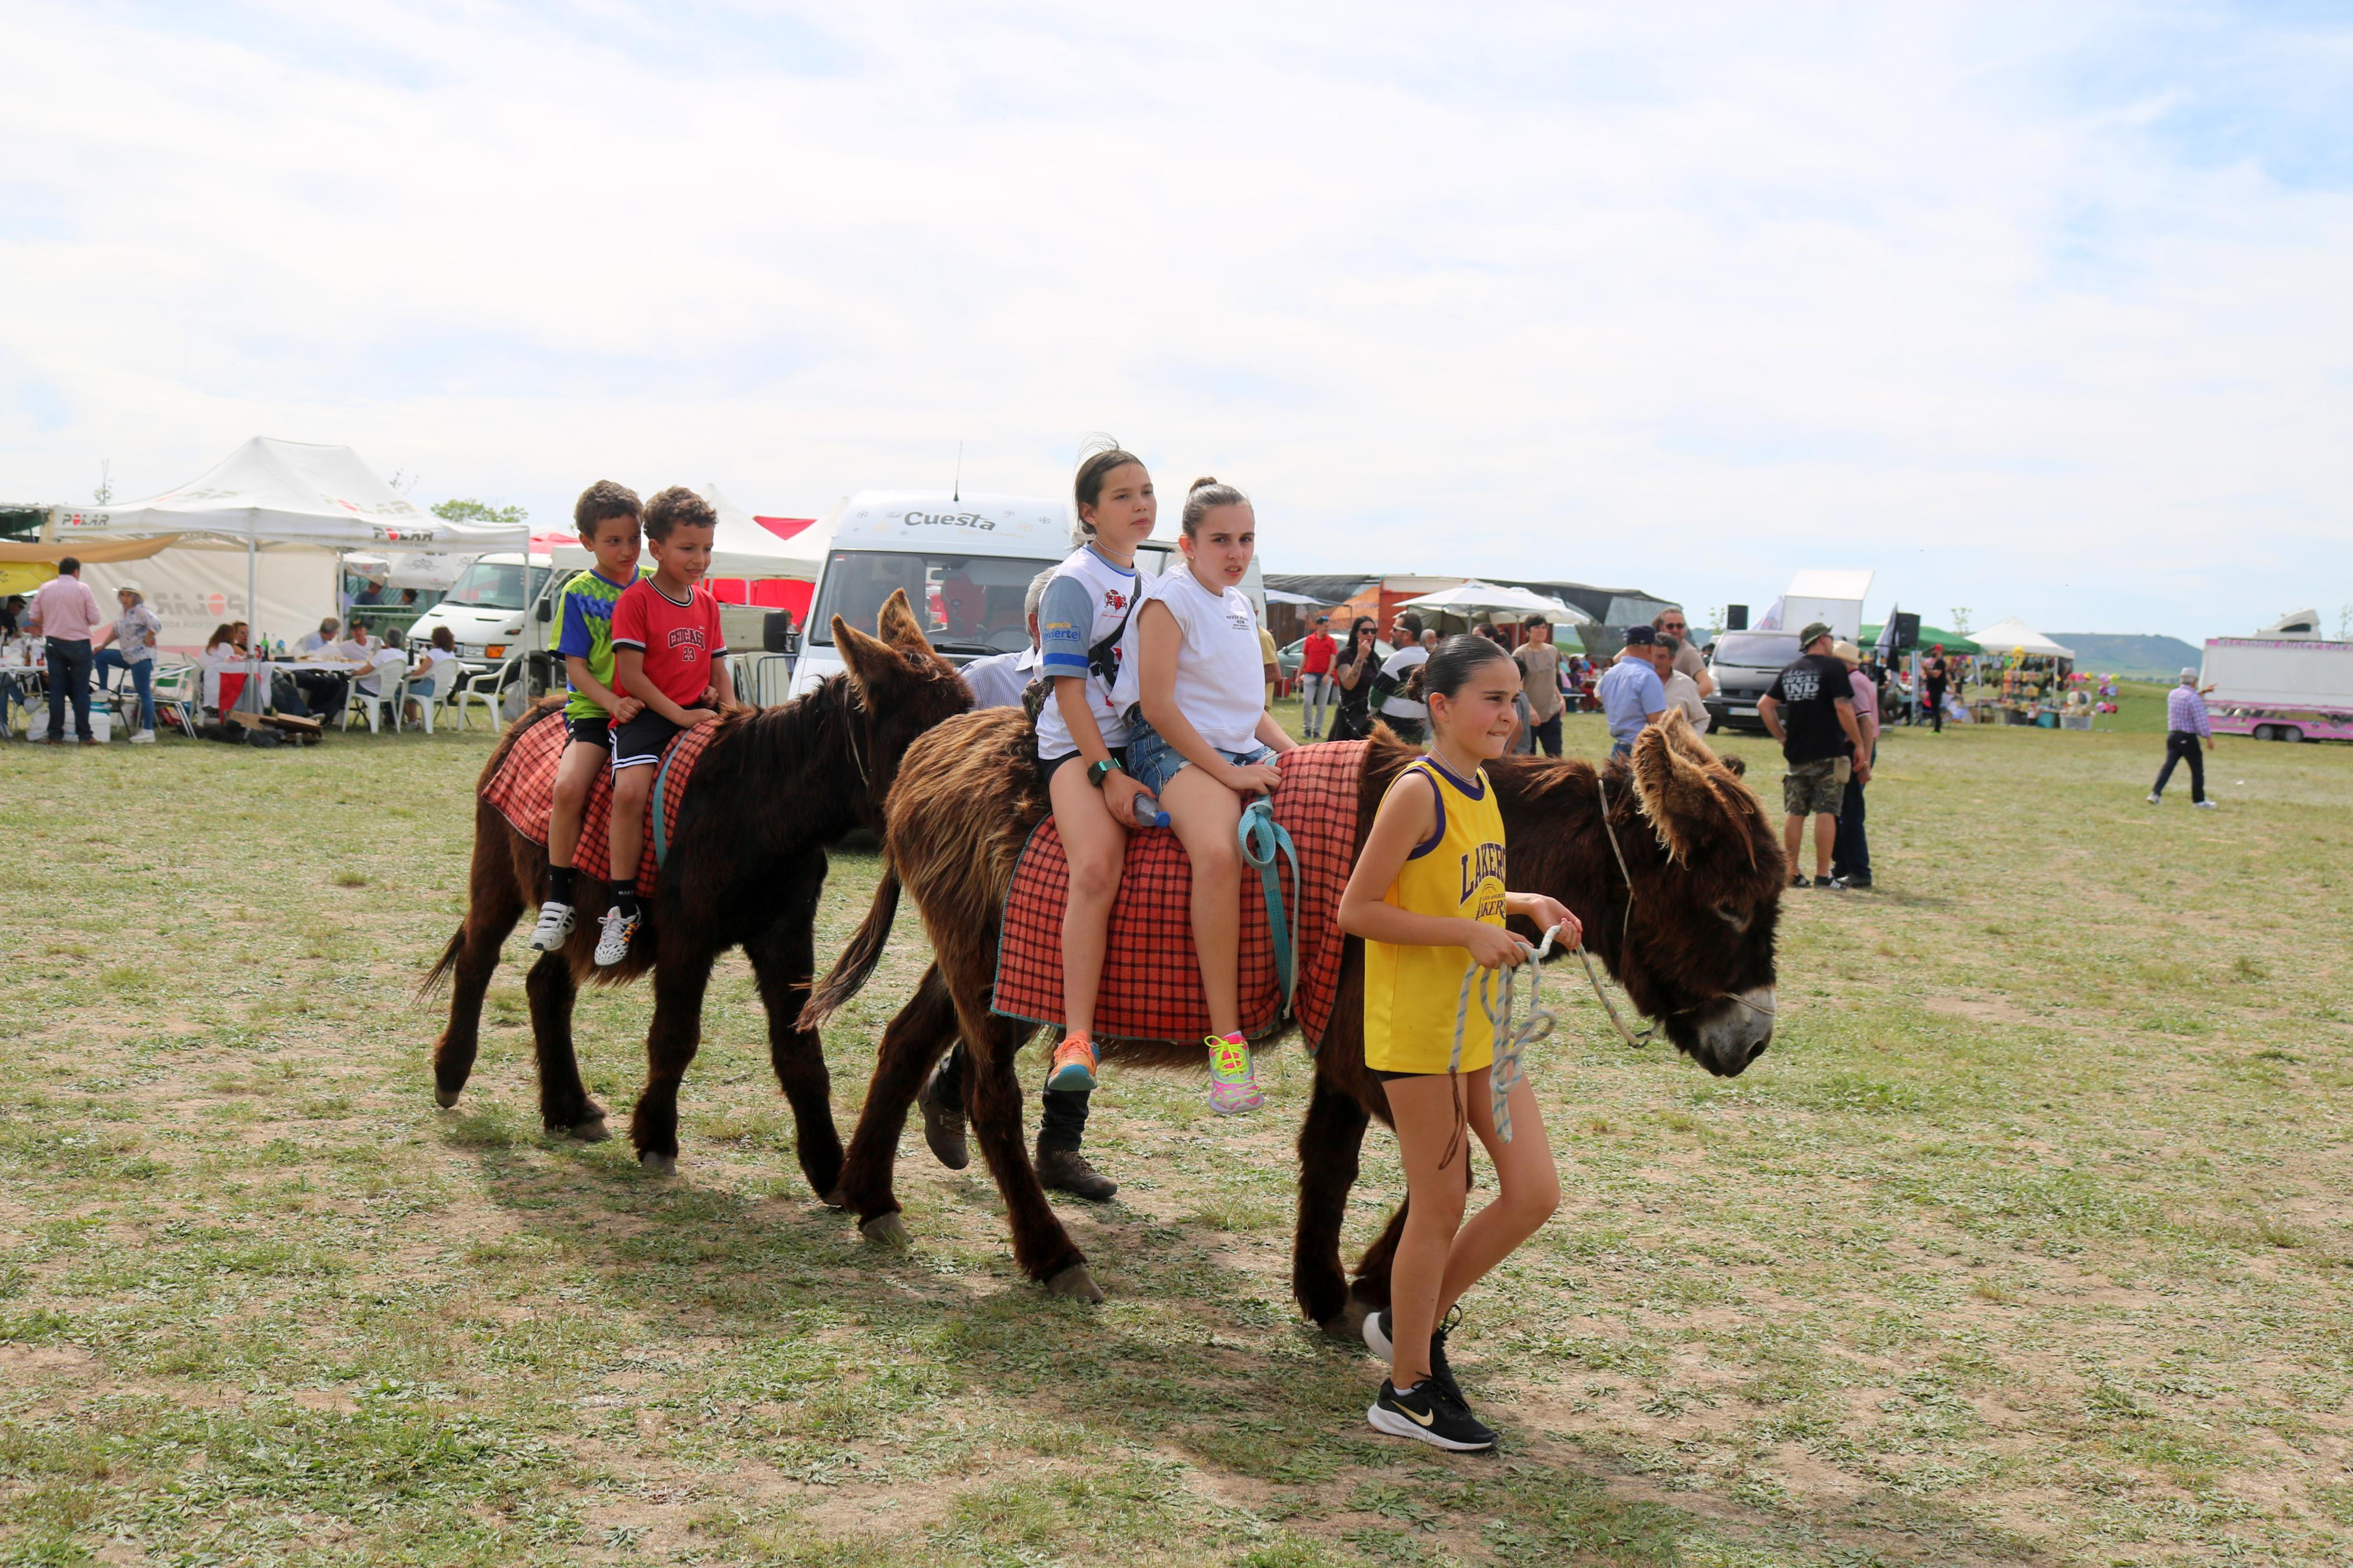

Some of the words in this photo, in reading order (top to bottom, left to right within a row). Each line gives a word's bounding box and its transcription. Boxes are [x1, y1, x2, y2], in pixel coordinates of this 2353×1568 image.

[61, 513, 109, 527] POLAR
[904, 511, 996, 531] Cuesta
[372, 526, 434, 541] POLAR
[682, 646, 695, 661] 23
[1786, 692, 1818, 701] EERS
